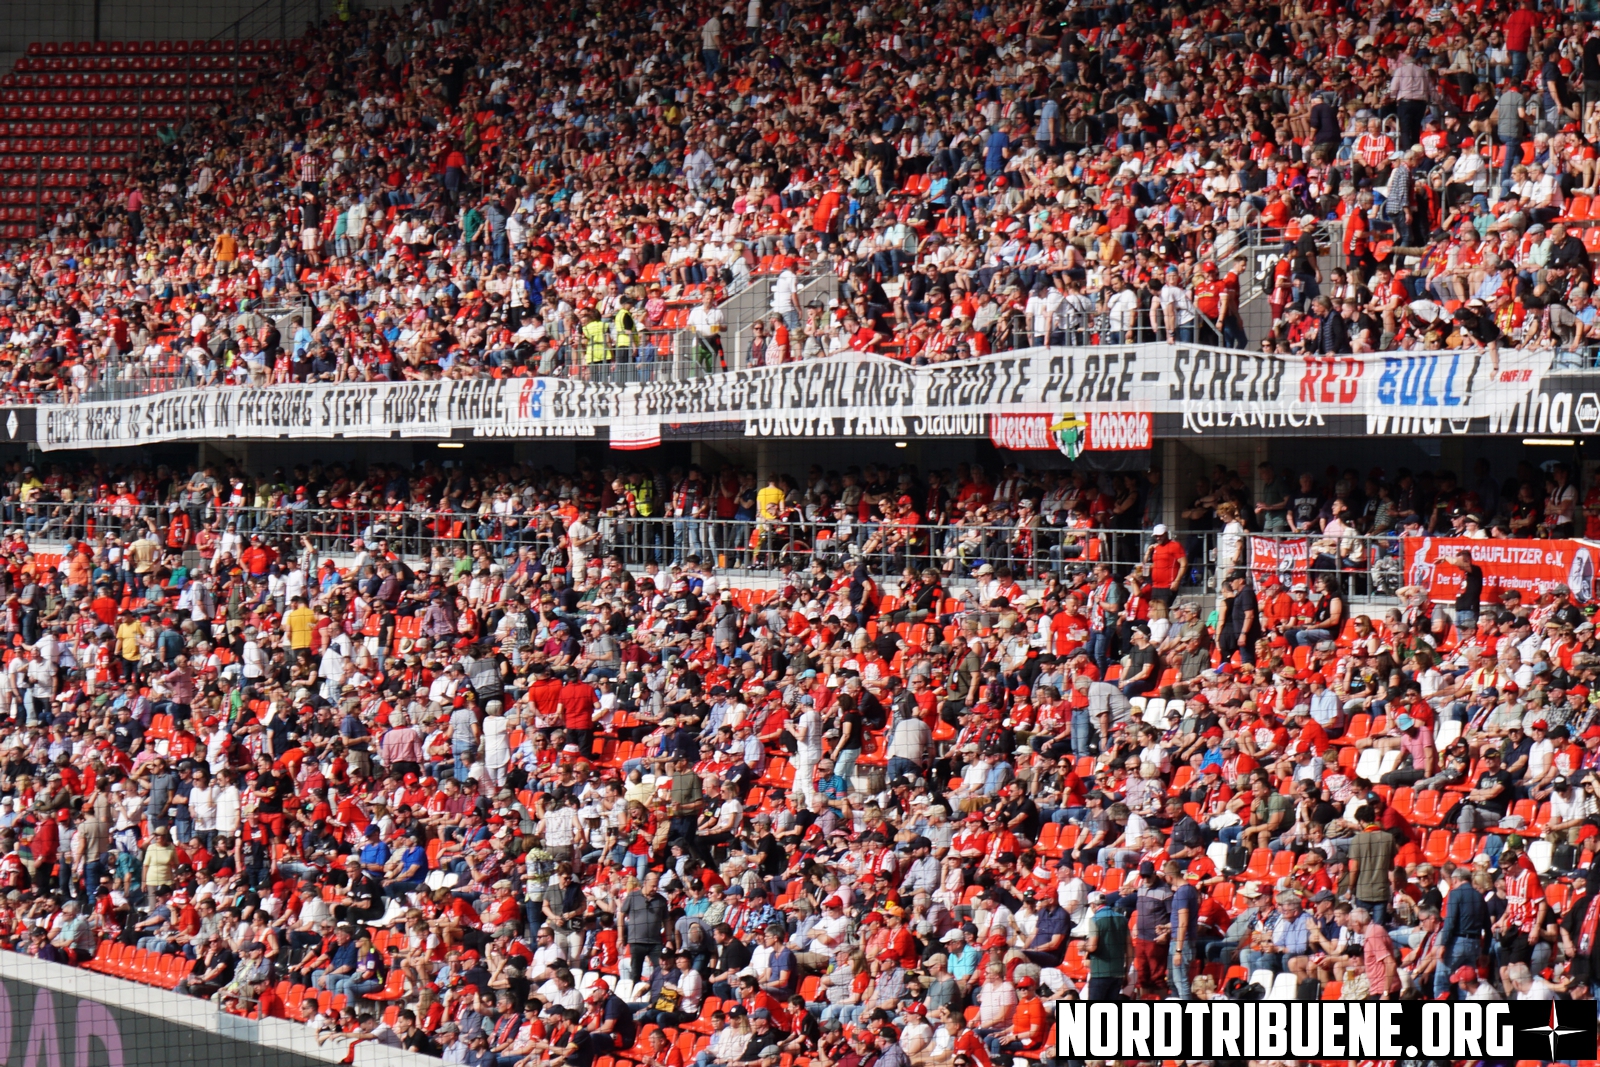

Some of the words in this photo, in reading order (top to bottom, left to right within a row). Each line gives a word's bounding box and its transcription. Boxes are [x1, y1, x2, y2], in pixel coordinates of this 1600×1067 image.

[47, 409, 80, 444] AUCH
[86, 406, 121, 440] NACH
[146, 392, 208, 436] SPIELEN
[214, 391, 232, 428] IN
[236, 389, 314, 428] FREIBURG
[322, 387, 378, 427] STEHT
[518, 378, 546, 418] RB
[553, 380, 626, 418] BLEIBT
[1041, 352, 1137, 402] PLAGE
[1299, 355, 1365, 403] RED
[1377, 353, 1482, 406] BULL!
[1437, 573, 1451, 585] Der
